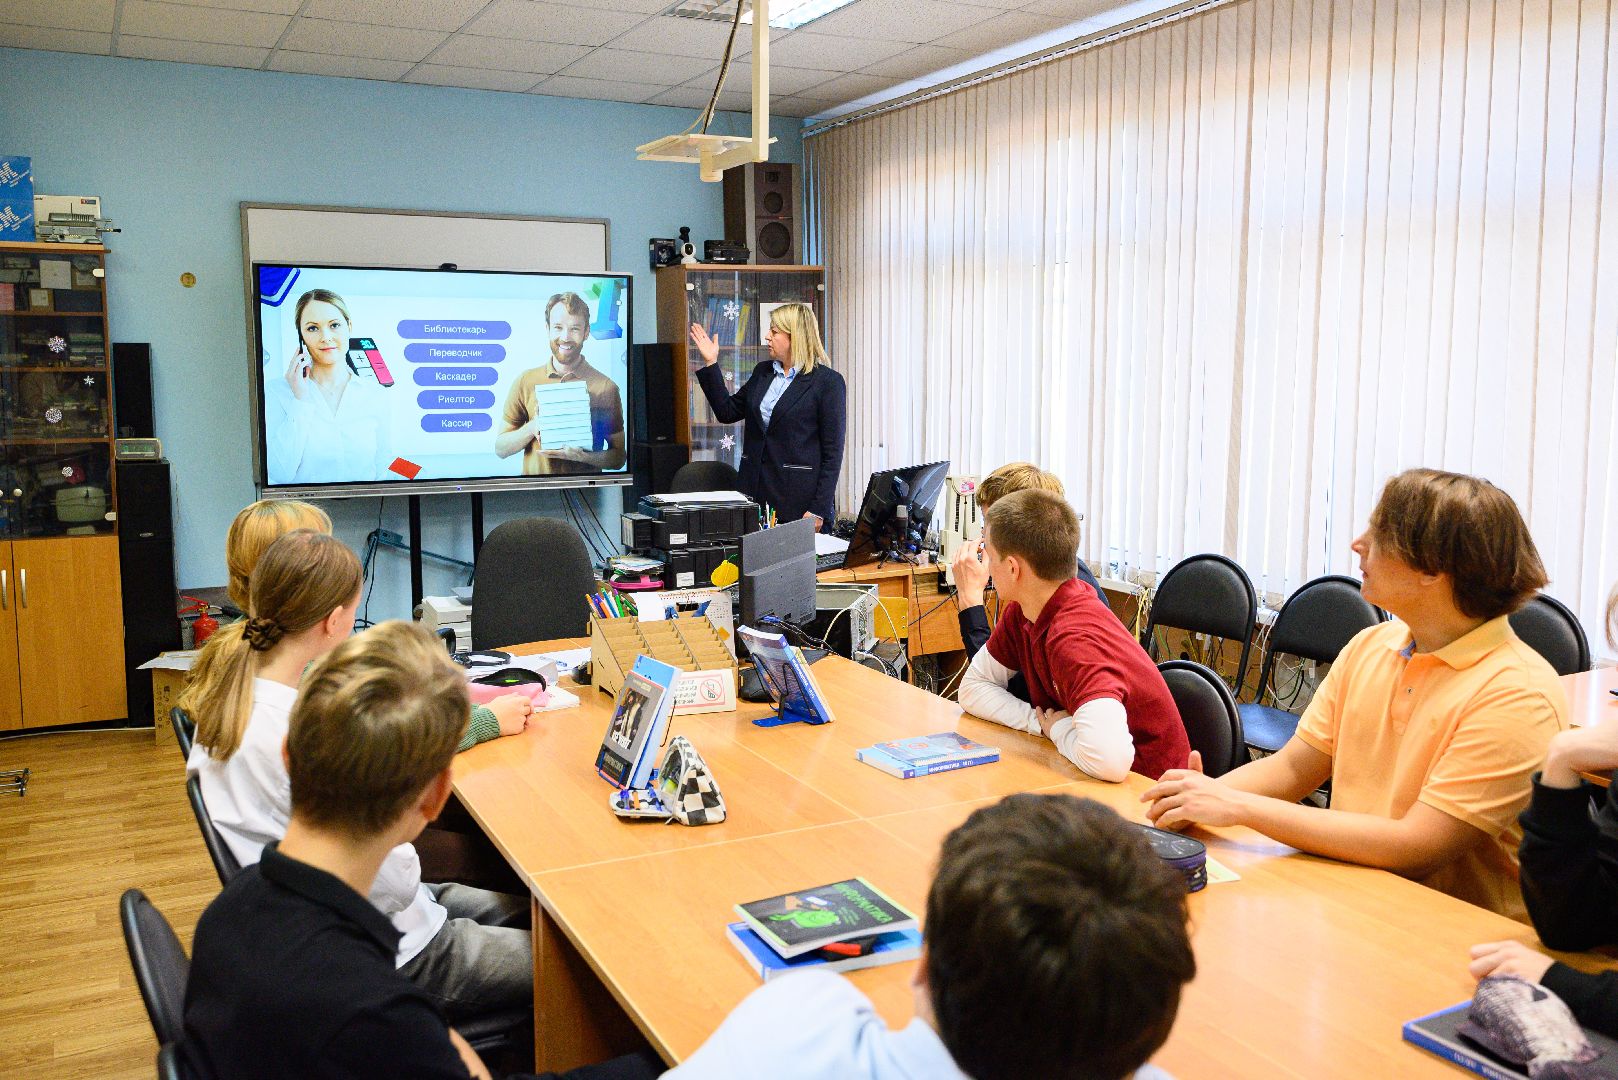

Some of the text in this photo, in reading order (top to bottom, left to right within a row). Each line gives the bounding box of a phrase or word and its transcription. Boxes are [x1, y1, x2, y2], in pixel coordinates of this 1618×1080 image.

[424, 324, 487, 334] Библиотекарь
[429, 348, 482, 358] Переводчик
[435, 372, 477, 381] Каскадер
[438, 395, 476, 404] Риелтор
[441, 419, 473, 428] Кассир
